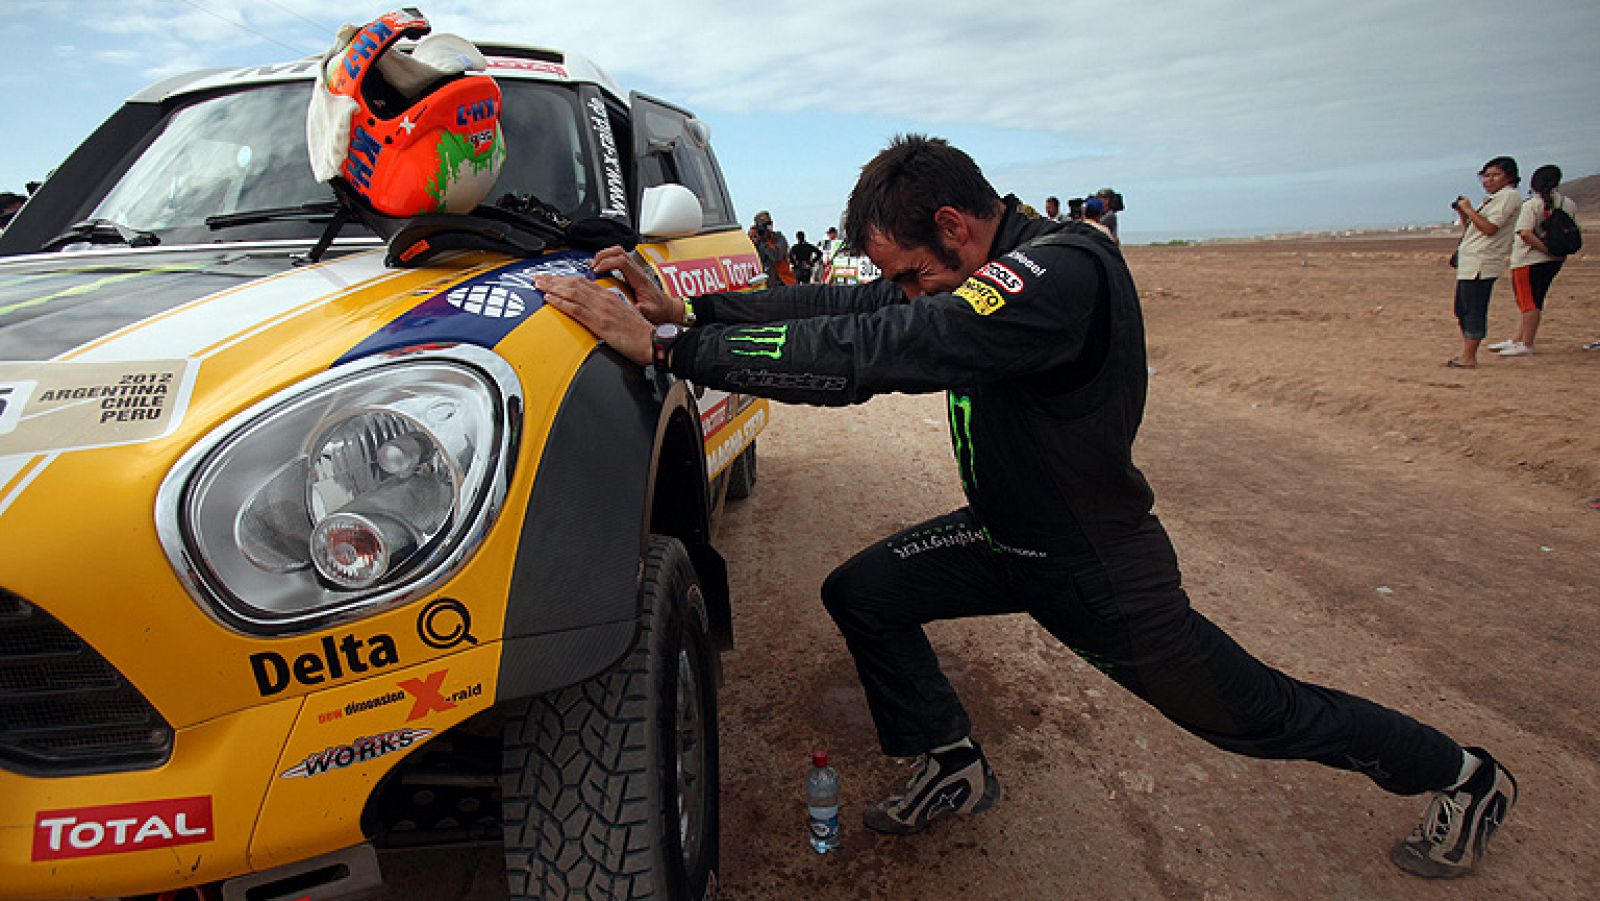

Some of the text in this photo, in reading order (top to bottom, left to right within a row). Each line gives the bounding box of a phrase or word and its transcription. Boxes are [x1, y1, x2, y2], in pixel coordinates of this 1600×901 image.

[662, 264, 727, 299] TOTAL
[118, 373, 173, 385] 2012
[39, 385, 168, 401] ARGENTINA
[101, 395, 165, 410] CHILE
[99, 408, 162, 424] PERU
[249, 632, 399, 696] Delta
[345, 690, 405, 716] dimension
[304, 728, 415, 778] WORKS
[39, 812, 207, 852] TOTAL
